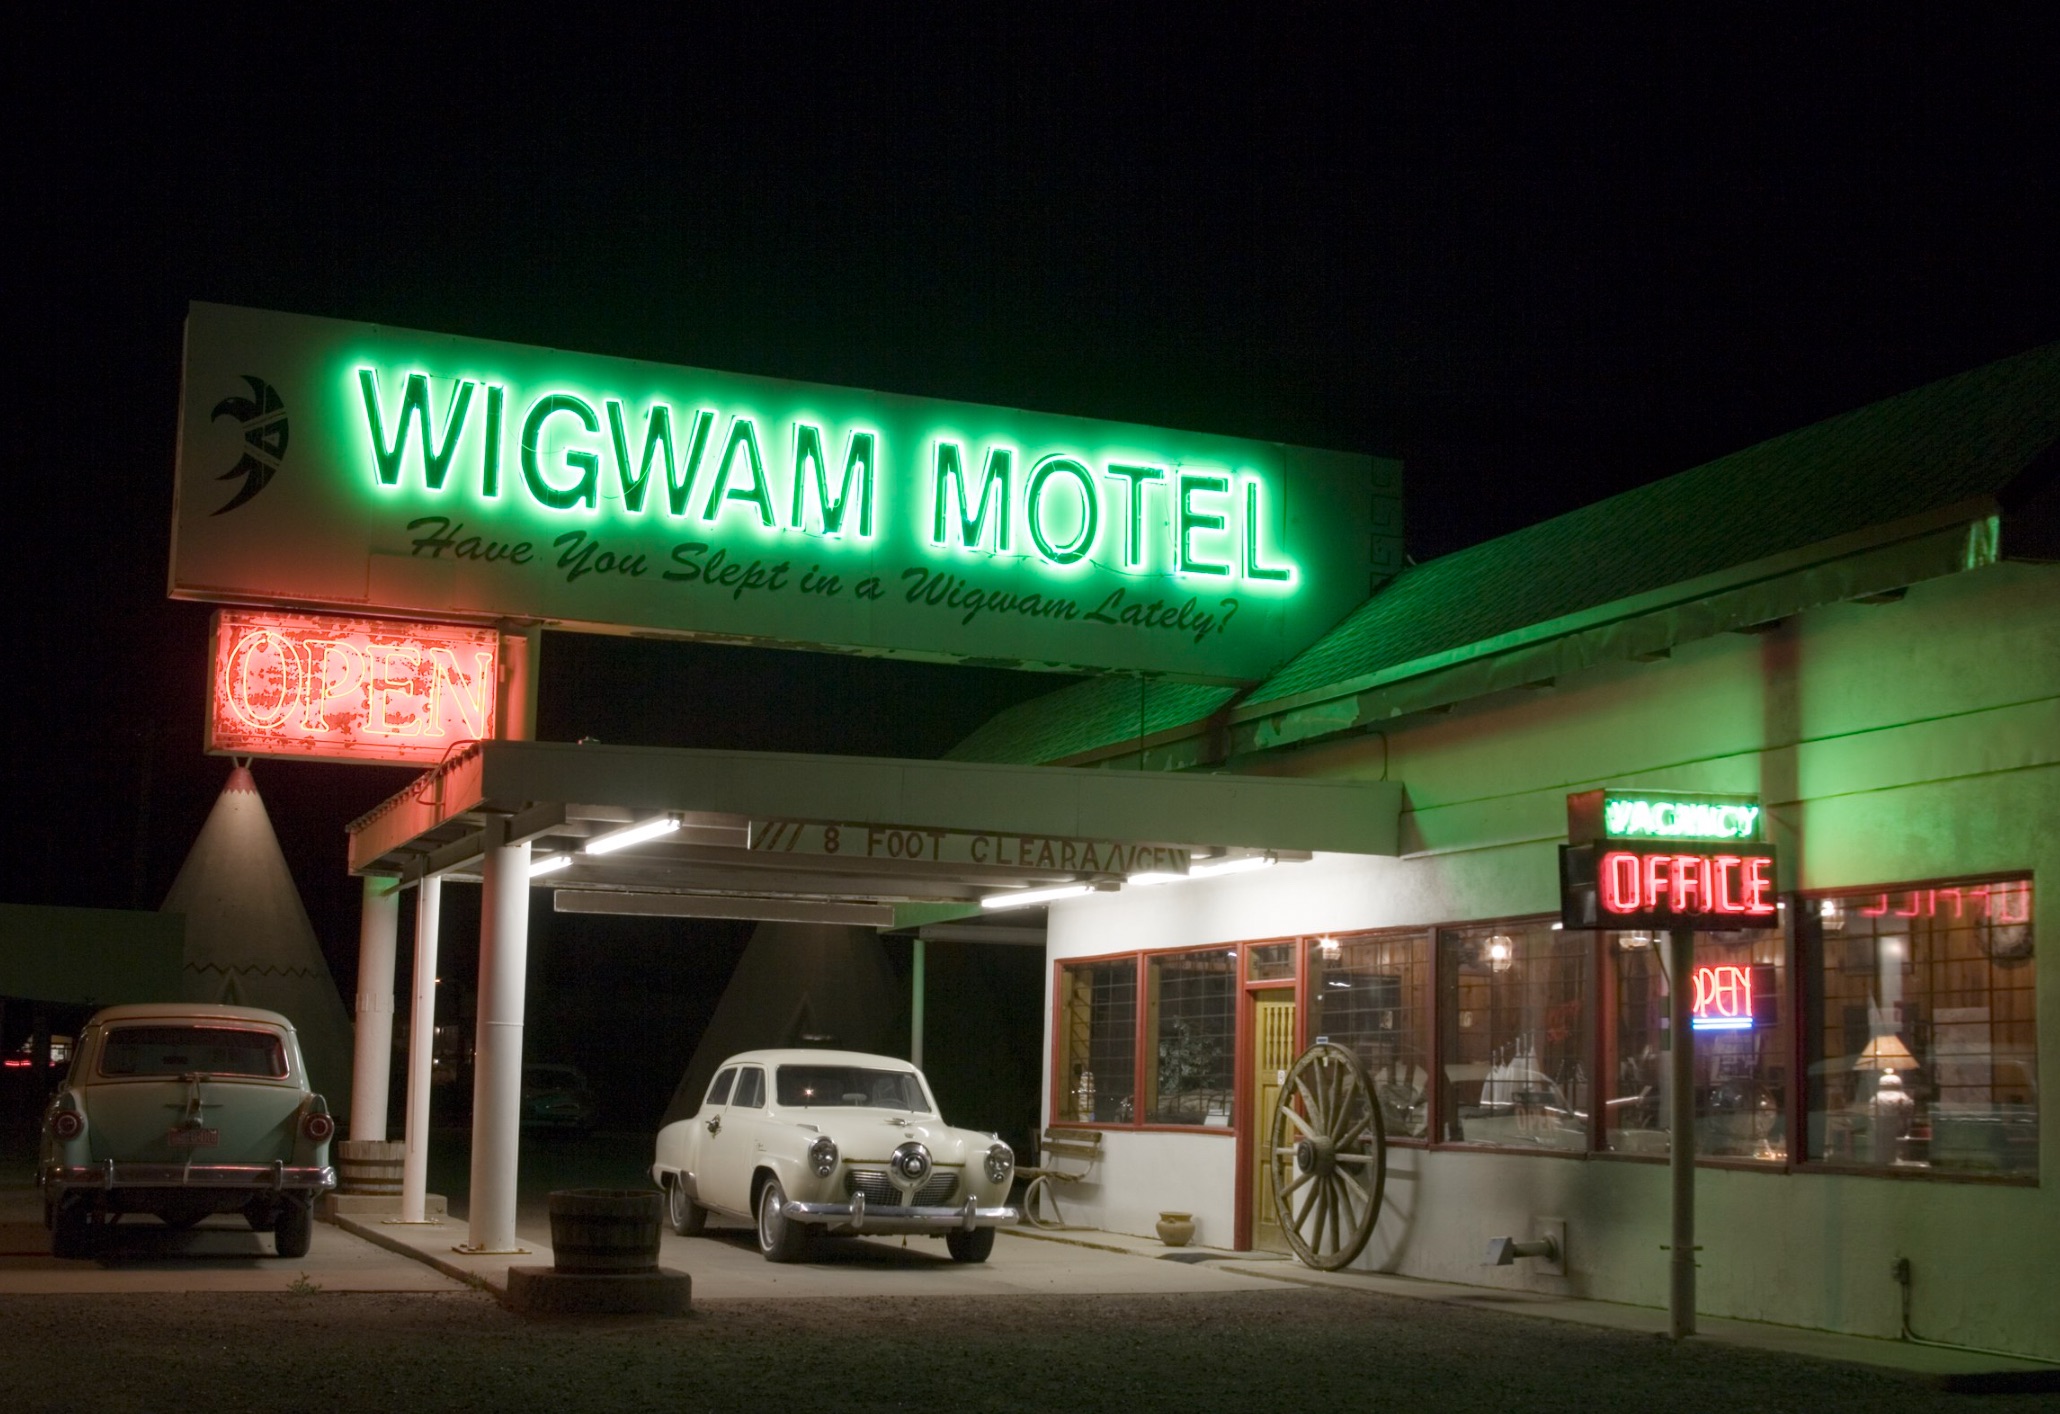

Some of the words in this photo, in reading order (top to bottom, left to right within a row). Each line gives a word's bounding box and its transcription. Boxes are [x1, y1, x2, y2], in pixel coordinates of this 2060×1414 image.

[354, 366, 881, 540] WIGWAM
[930, 437, 1298, 584] MOTEL
[406, 515, 534, 565] Have
[552, 529, 649, 583] You
[662, 541, 791, 600] Slept
[800, 563, 843, 597] in
[854, 576, 885, 600] a
[901, 566, 1081, 626] Wigwam
[1083, 586, 1239, 644] Lately?
[224, 629, 496, 742] OPEN
[823, 825, 841, 855] 8
[866, 827, 947, 863] FOOT
[1605, 799, 1759, 838] VACANCY
[1601, 851, 1776, 915] OFFICE
